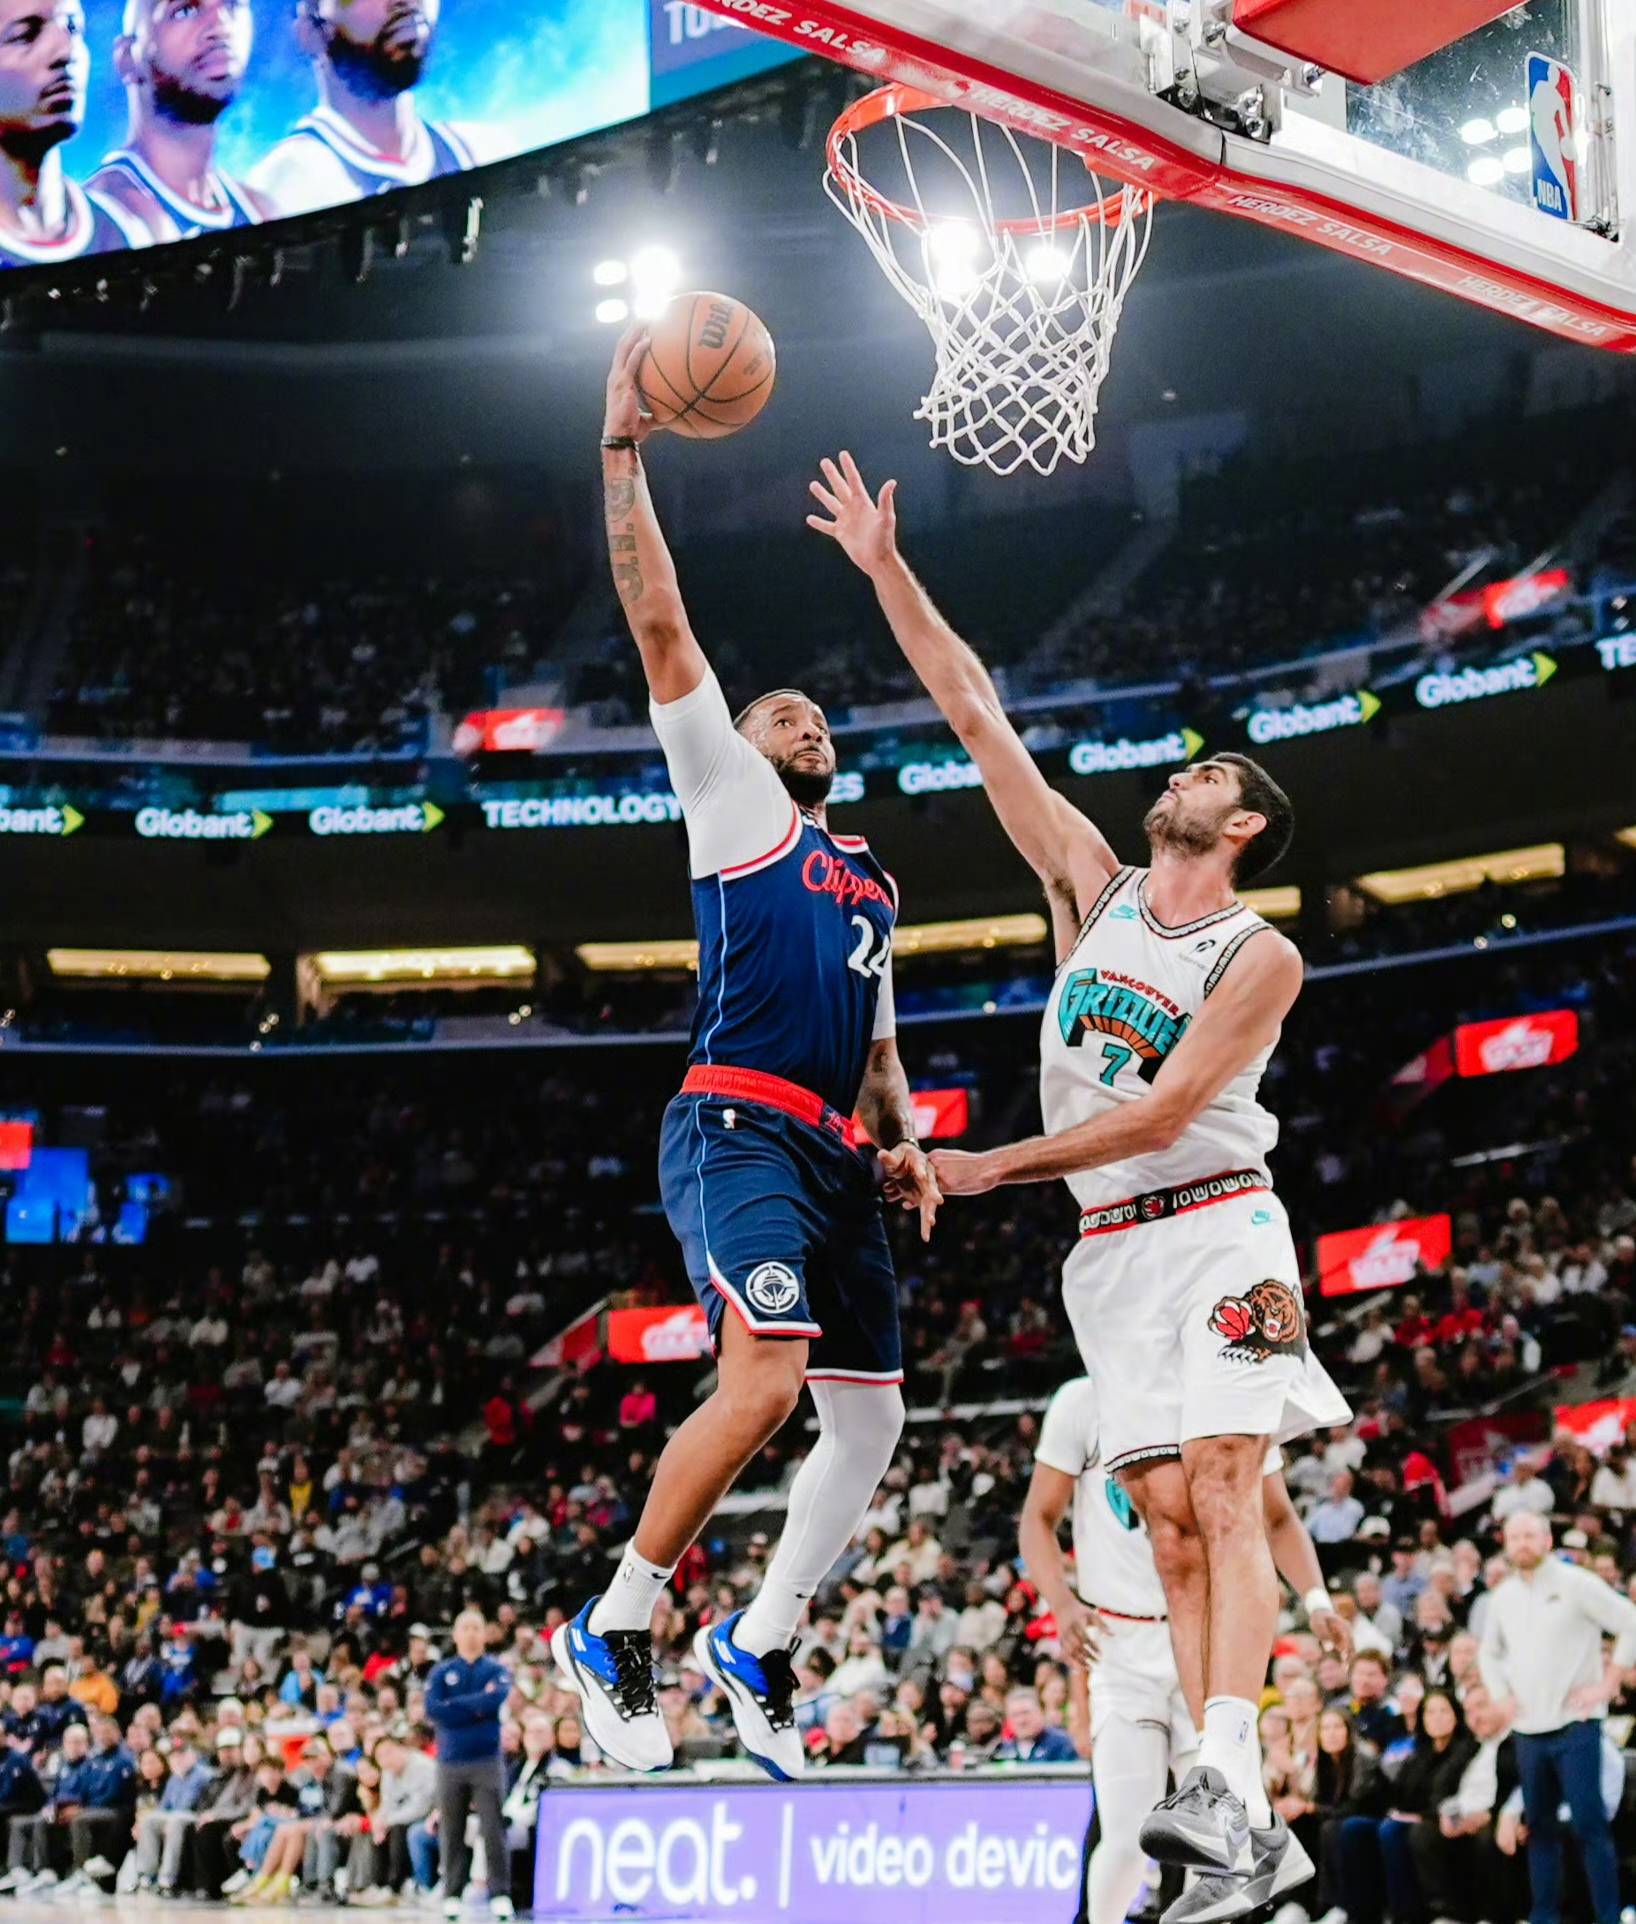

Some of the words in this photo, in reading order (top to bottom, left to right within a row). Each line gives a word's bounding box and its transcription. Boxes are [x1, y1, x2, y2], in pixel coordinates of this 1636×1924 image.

[792, 20, 887, 64] SALSA
[968, 82, 1073, 132] HERDEZ
[1070, 127, 1155, 172] SALSA
[1537, 178, 1563, 212] NBA
[1228, 194, 1319, 226] HERDEZ
[1316, 221, 1393, 256] SALSA
[1457, 275, 1539, 315] HERDEZ
[1416, 657, 1537, 708] Globant
[1248, 694, 1362, 744] Globant
[1070, 732, 1186, 775] Globant
[135, 809, 254, 838] Globant
[309, 804, 425, 835] Globant
[481, 793, 681, 829] TECHNOLOGY
[847, 914, 892, 978] 24
[1101, 970, 1180, 1016] VANCOUVER
[1099, 1042, 1132, 1087] 7
[556, 1802, 757, 1904] neat.
[810, 1822, 933, 1887] video
[946, 1820, 1077, 1890] devic
